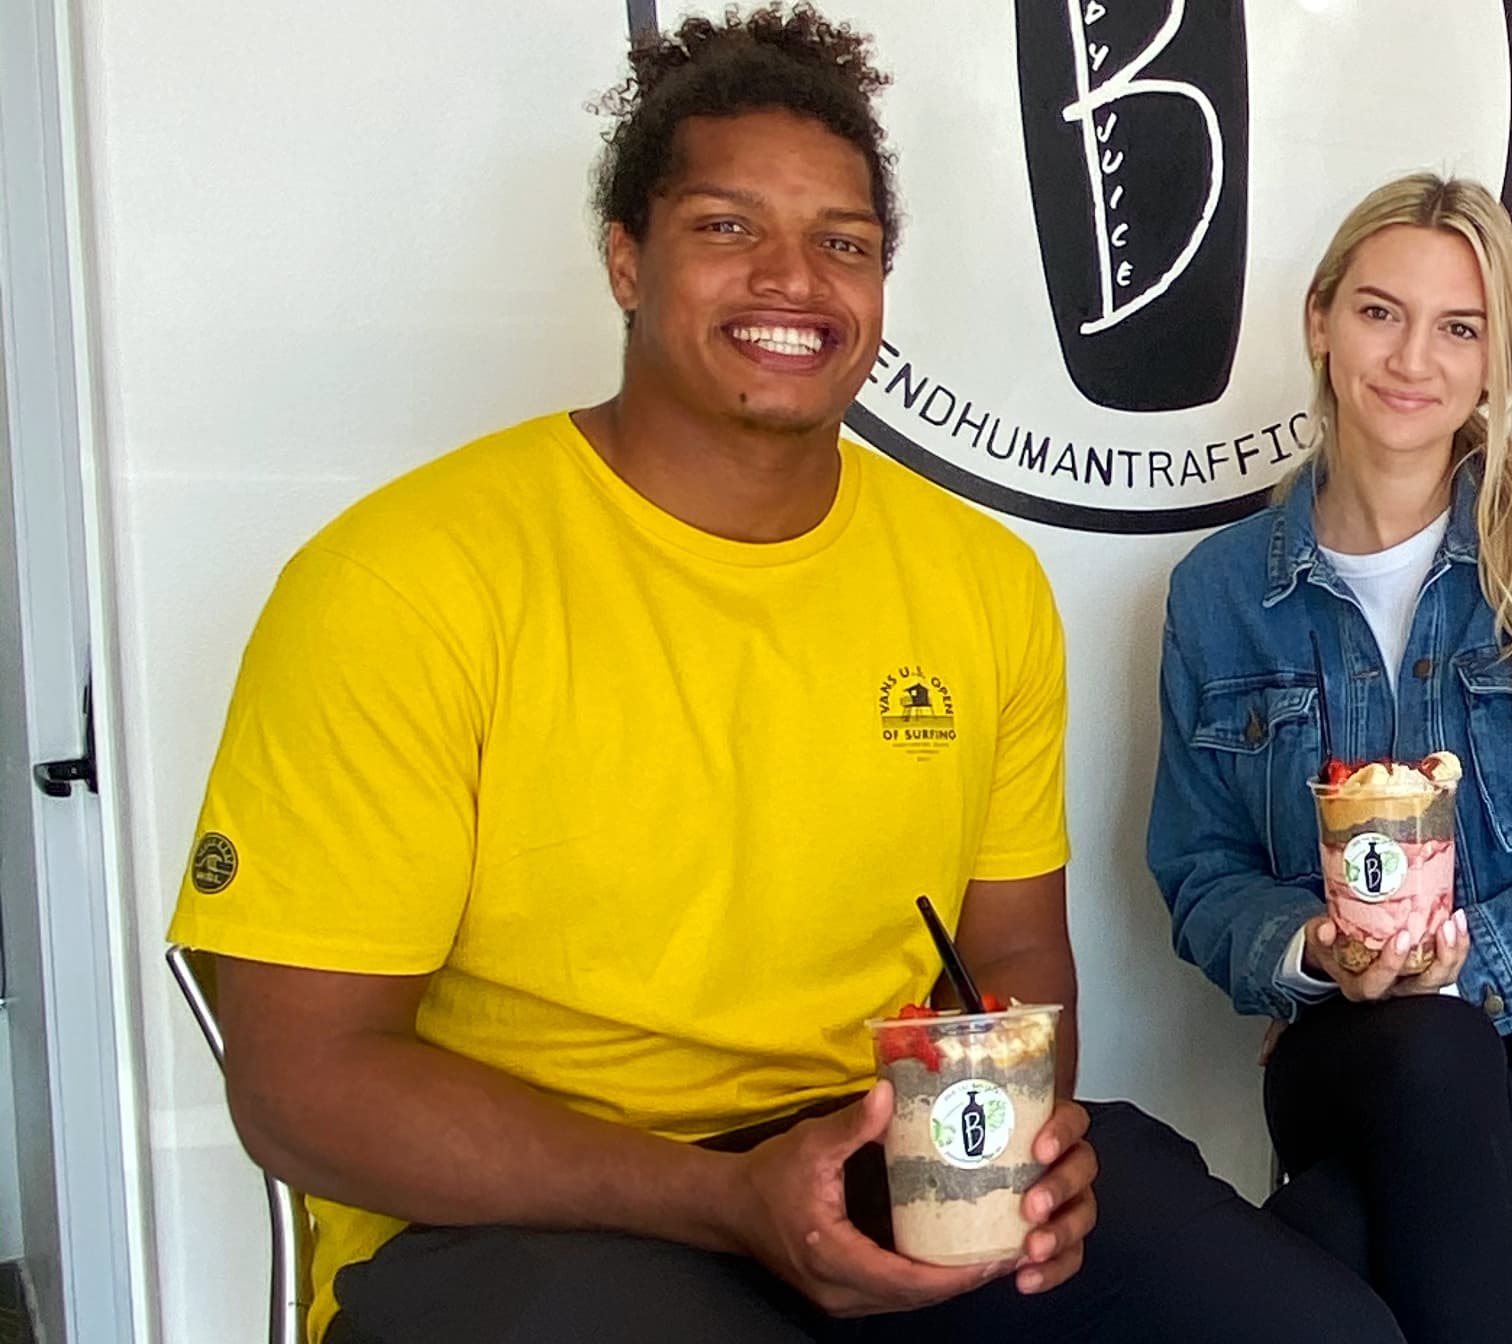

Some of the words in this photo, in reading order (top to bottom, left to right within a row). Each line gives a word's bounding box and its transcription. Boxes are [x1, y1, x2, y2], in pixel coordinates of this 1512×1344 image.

[879, 674, 898, 715] VANS
[931, 677, 954, 715] OPEN
[883, 729, 899, 741] OF
[904, 729, 957, 741] SURFING
[1366, 858, 1381, 889] B
[964, 1111, 985, 1153] B
